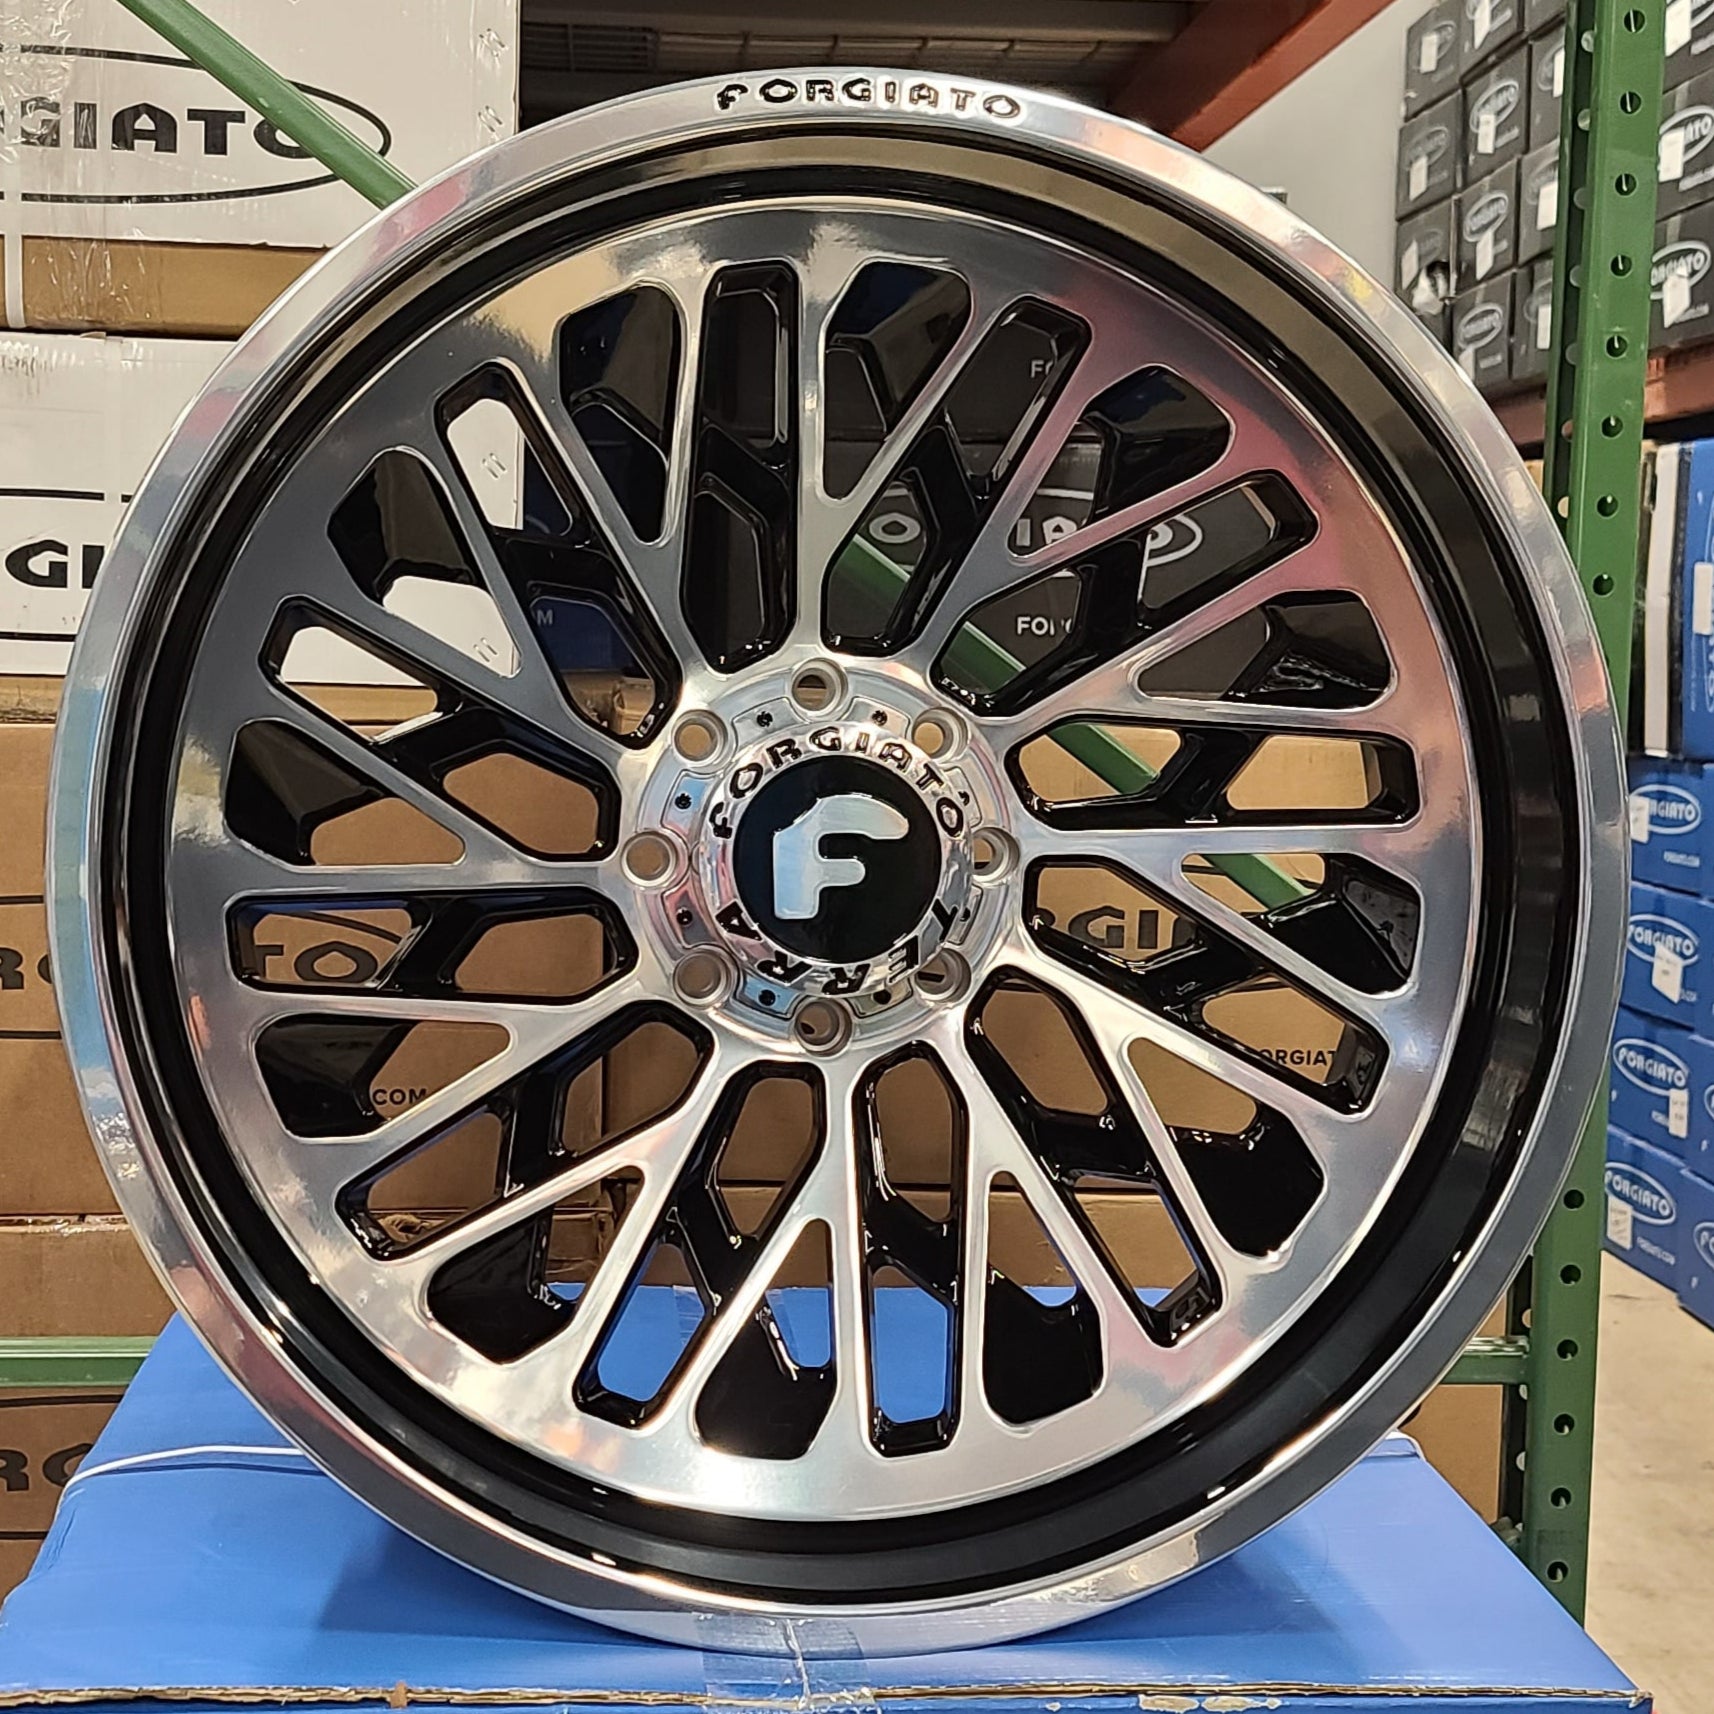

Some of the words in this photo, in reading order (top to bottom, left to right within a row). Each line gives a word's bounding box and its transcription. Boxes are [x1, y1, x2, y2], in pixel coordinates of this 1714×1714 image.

[715, 76, 1023, 120] FORGIATO
[708, 726, 965, 840] FORGIATO
[1618, 1046, 1686, 1088] FORGIATO
